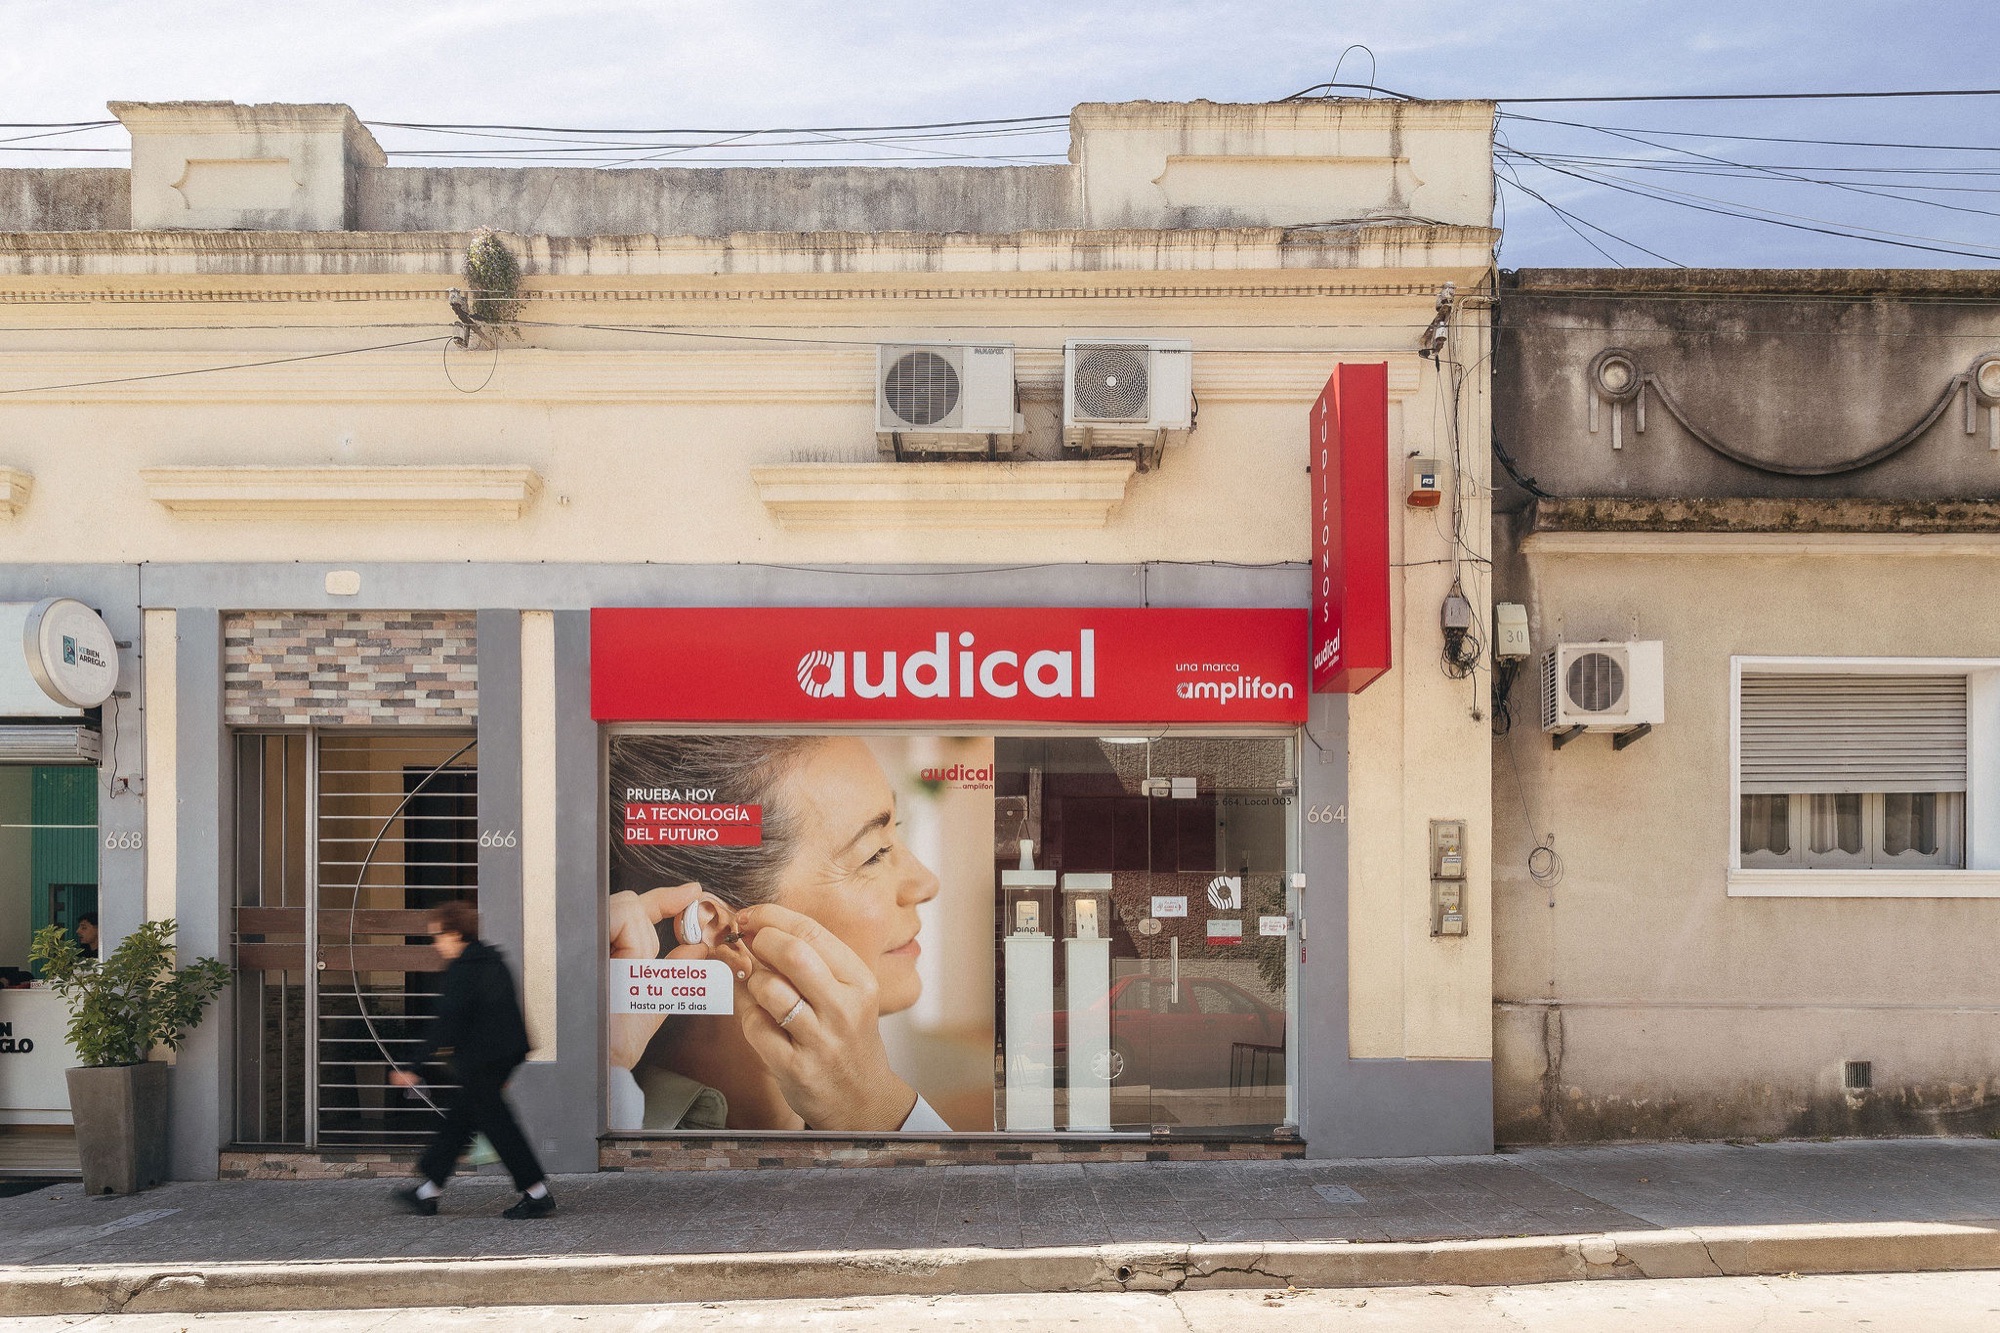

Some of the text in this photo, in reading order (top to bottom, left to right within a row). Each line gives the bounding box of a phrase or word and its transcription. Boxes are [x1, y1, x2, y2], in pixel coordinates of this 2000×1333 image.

[1320, 397, 1331, 623] AUDIFONOS
[1506, 629, 1524, 643] 30
[1313, 627, 1340, 670] audical
[79, 654, 107, 668] ARREGLO
[797, 628, 1095, 699] audical
[1175, 663, 1240, 672] una marca
[1176, 675, 1294, 705] amplifon
[920, 763, 993, 781] audical
[626, 788, 717, 801] PRUEBA HOY
[1244, 797, 1269, 806] Local
[1272, 797, 1291, 806] 003
[626, 805, 750, 821] LA TECNOLOGÍA
[1307, 804, 1347, 824] 664
[105, 831, 143, 849] 668
[479, 830, 517, 848] 666
[626, 828, 719, 841] DEL FUTURO
[630, 965, 707, 979] Llévatelos
[629, 984, 706, 997] a tu casa
[630, 1001, 656, 1010] Hasta
[659, 1002, 675, 1012] por
[677, 1002, 686, 1010] 15
